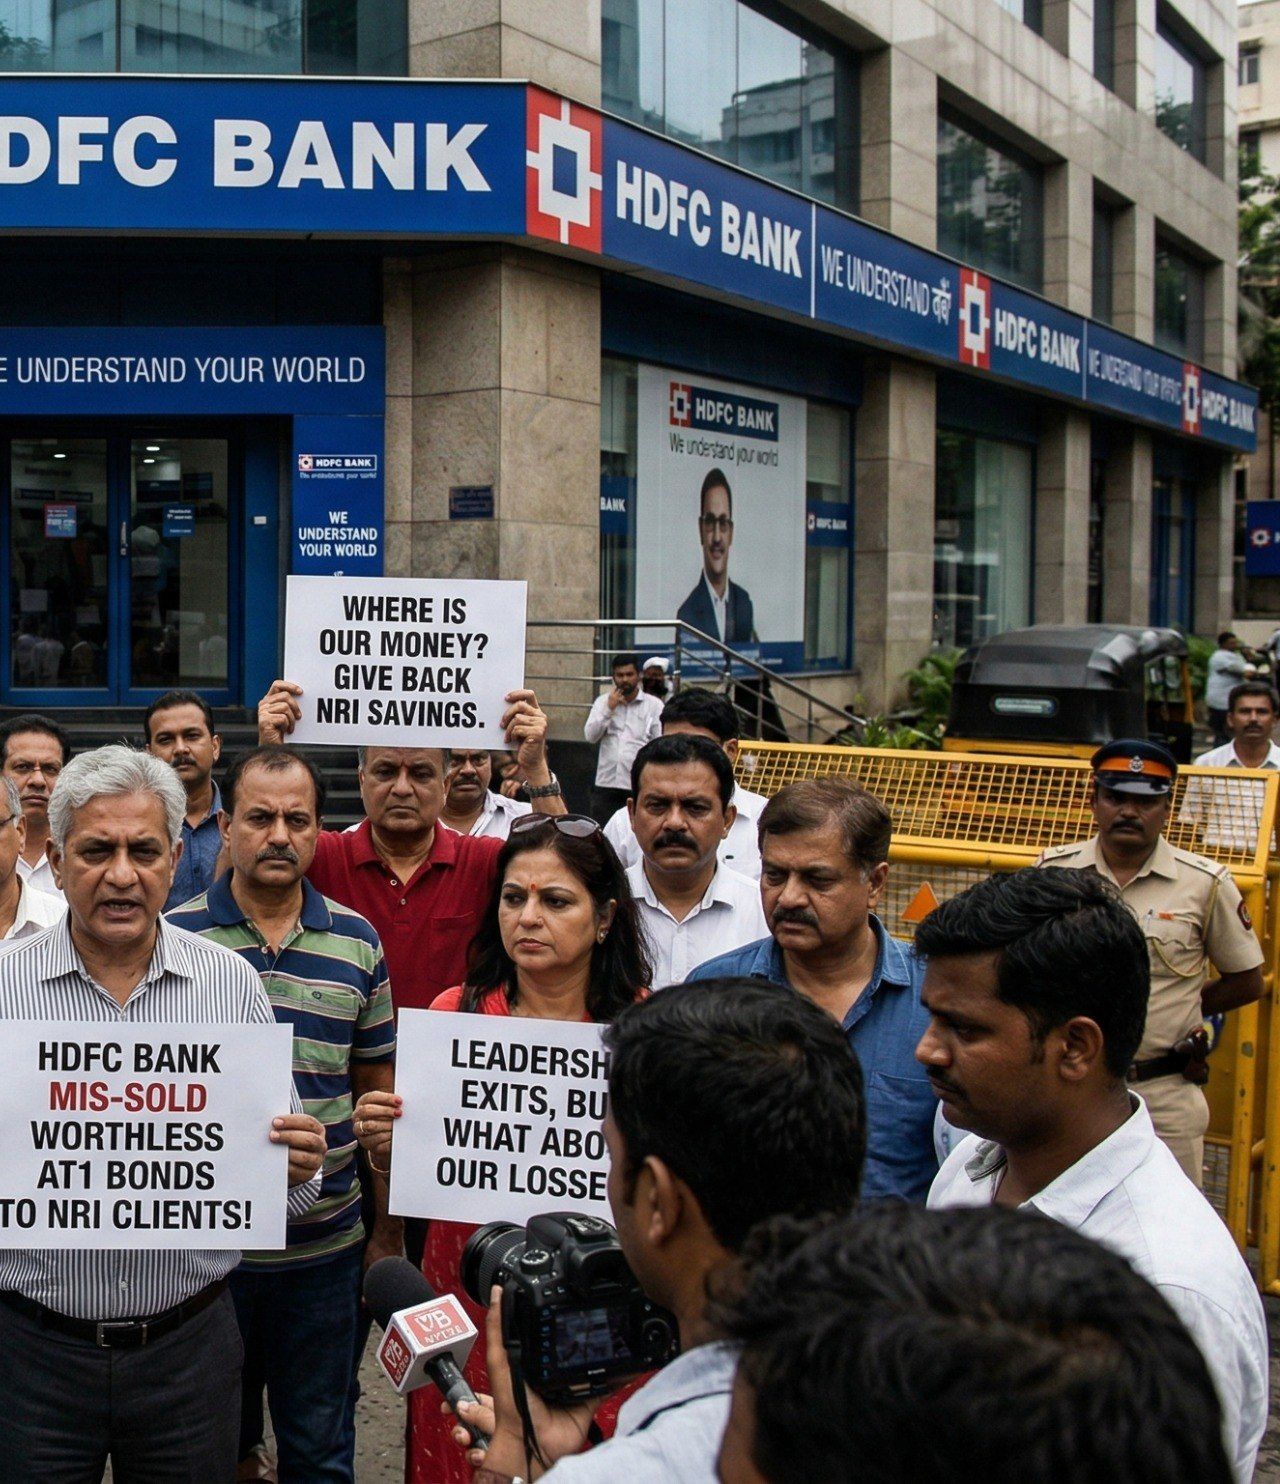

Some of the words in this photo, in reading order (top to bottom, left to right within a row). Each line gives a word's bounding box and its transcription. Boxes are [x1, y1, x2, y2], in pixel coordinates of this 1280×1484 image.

[213, 118, 492, 192] BANK
[616, 159, 711, 248] HDFC
[721, 200, 803, 278] BANK
[821, 244, 844, 288] WE
[847, 254, 930, 317] UNDERSTAND
[994, 307, 1037, 359] HDFC
[1040, 325, 1080, 374] BANK
[17, 357, 187, 384] UNDERSTAND
[194, 357, 265, 384] YOUR
[271, 357, 366, 384] WORLD
[695, 398, 733, 425] HDFC
[737, 405, 774, 432] BANK
[344, 458, 372, 467] BANK
[328, 511, 348, 525] WE
[600, 496, 626, 512] BANK
[298, 527, 378, 541] UNDERSTAND
[299, 543, 331, 557] YOUR
[334, 543, 377, 557] WORLD
[342, 595, 433, 623] WHERE
[443, 598, 467, 624] IS
[319, 628, 371, 656] OUR
[380, 631, 489, 659] MONEY?
[334, 664, 393, 691] GIVE
[402, 666, 472, 694] BACK
[316, 697, 359, 724] NRI
[367, 698, 485, 729] SAVINGS.
[38, 1041, 122, 1072] HDFC
[133, 1043, 222, 1074] BANK
[451, 1038, 611, 1080] LEADERSH
[49, 1081, 208, 1112] MIS-SOLD
[461, 1079, 556, 1122] EXITS,
[567, 1088, 608, 1120] BU
[30, 1120, 225, 1152] WORTHLESS
[443, 1117, 532, 1154] WHAT
[539, 1127, 606, 1161] ABO
[36, 1160, 92, 1190] AT1
[106, 1160, 216, 1190] BONDS
[436, 1156, 498, 1191] OUR
[508, 1163, 607, 1202] LOSSE
[48, 1199, 101, 1230] NRI
[112, 1200, 253, 1231] CLIENTS!
